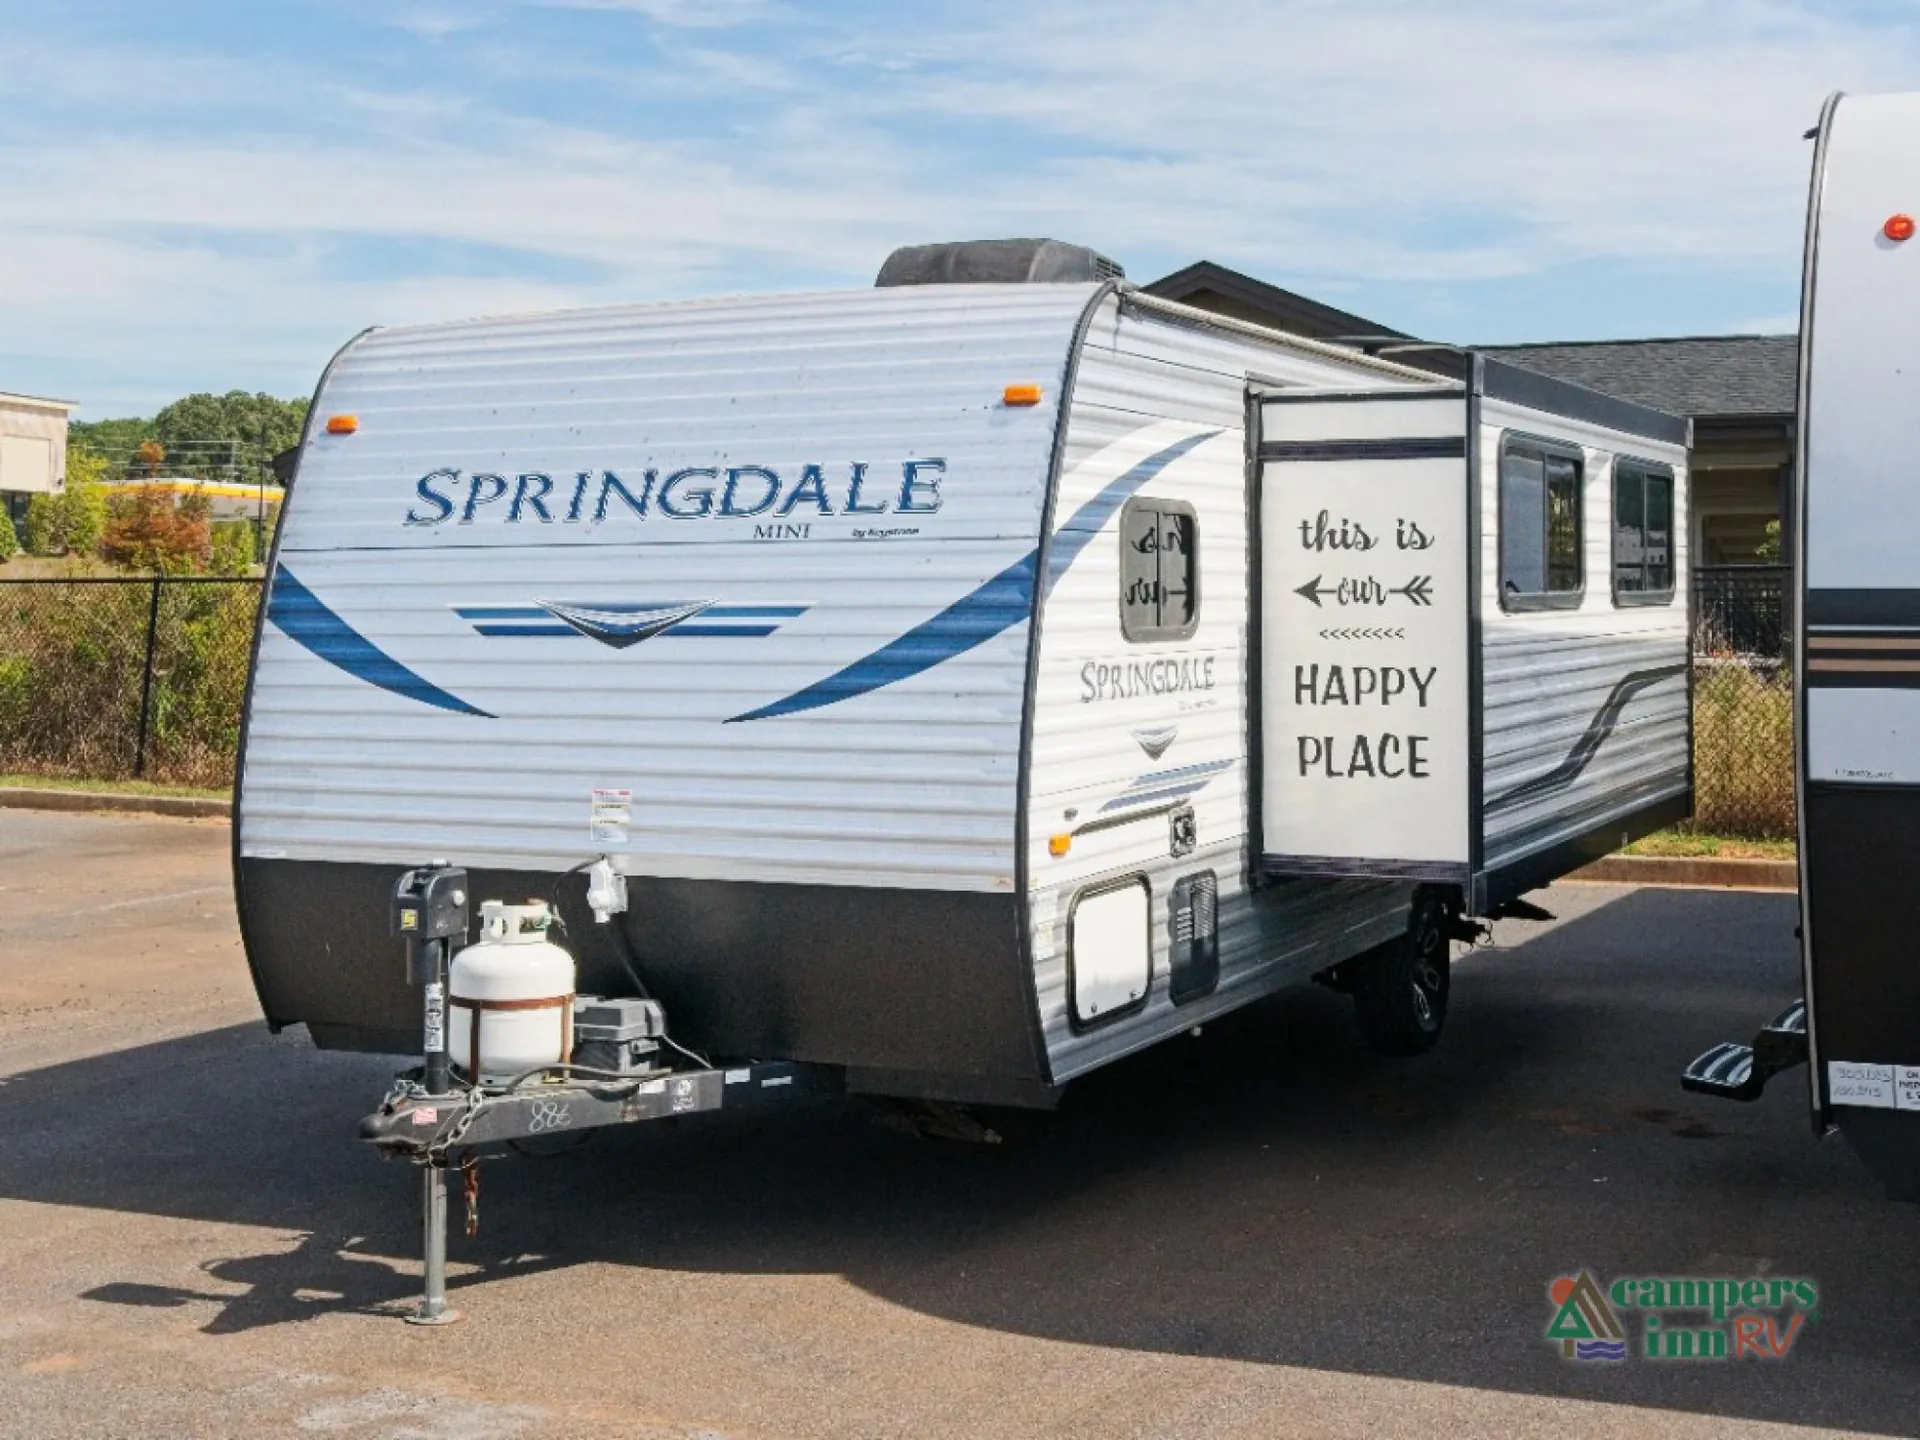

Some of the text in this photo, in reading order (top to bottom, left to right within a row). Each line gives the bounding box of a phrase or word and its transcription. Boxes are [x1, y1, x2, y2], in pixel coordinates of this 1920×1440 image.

[403, 457, 948, 527] SPRINGDALE
[753, 523, 811, 539] MINI
[1297, 509, 1435, 552] this is
[1337, 575, 1388, 606] our
[1080, 656, 1216, 703] SPRINGDALE
[1295, 663, 1437, 707] HAPPY
[1297, 732, 1430, 778] PLACE
